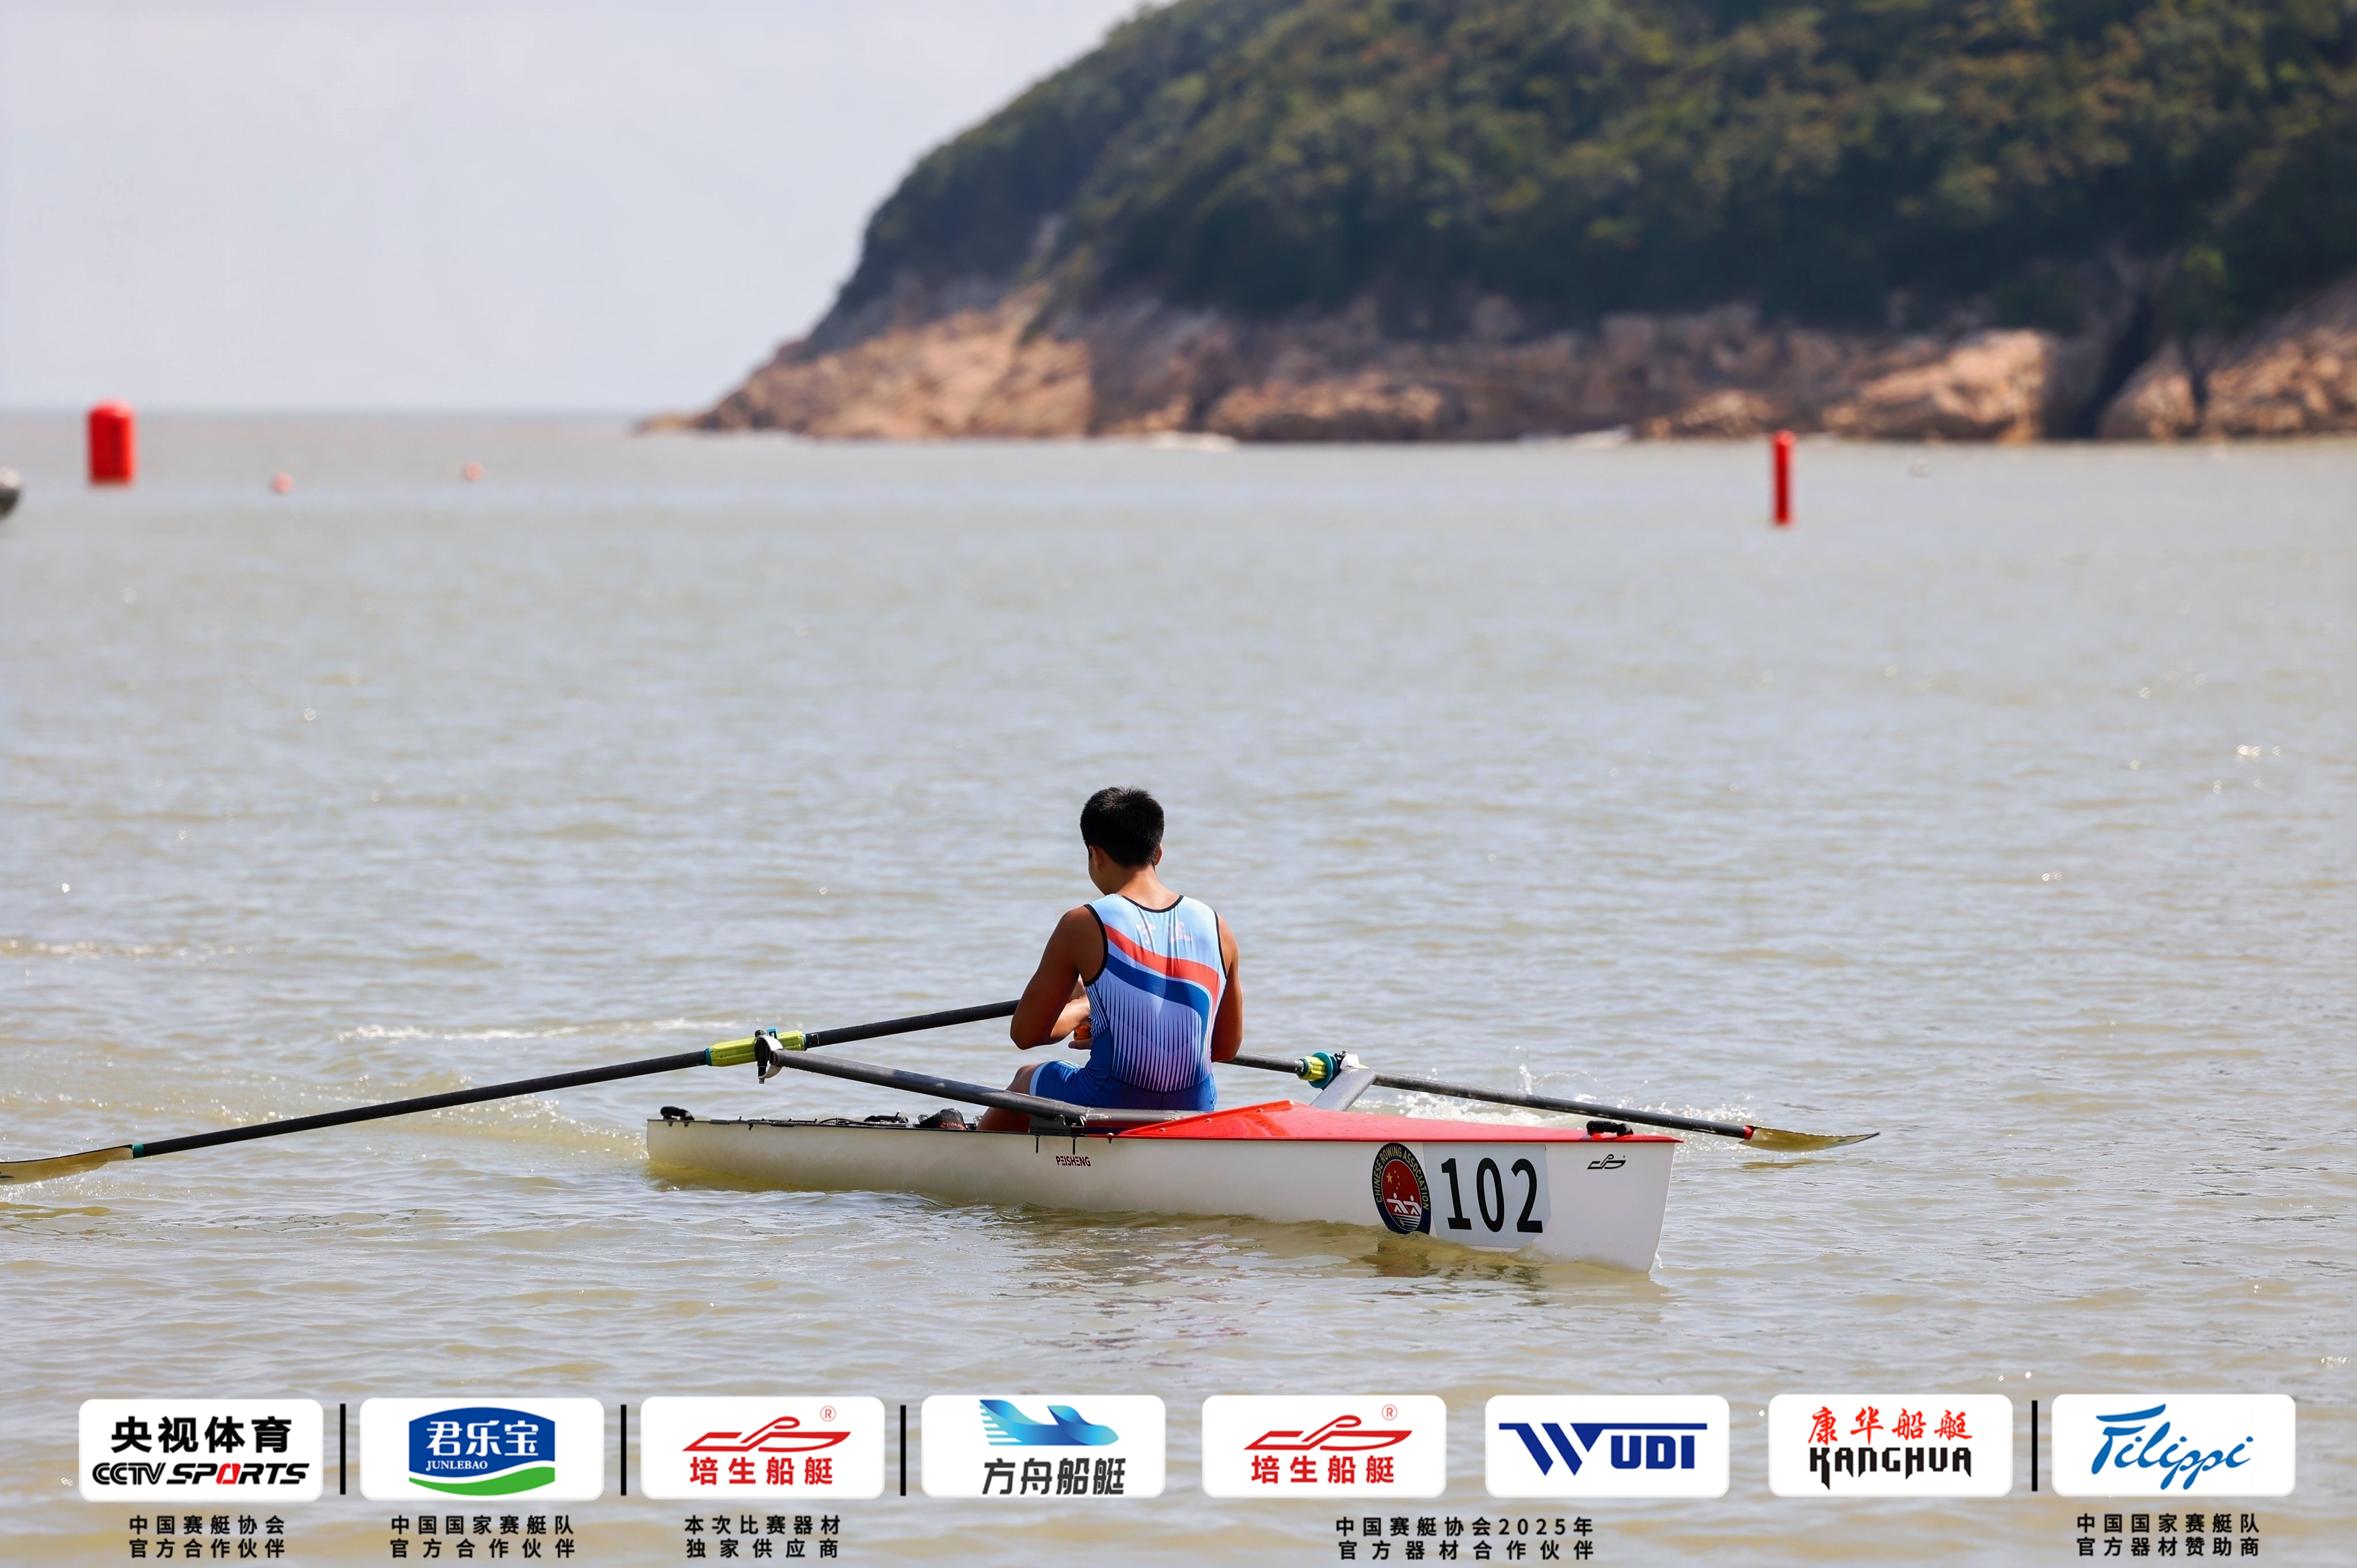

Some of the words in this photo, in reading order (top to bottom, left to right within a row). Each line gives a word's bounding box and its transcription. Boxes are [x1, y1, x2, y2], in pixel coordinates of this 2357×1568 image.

[1055, 1155, 1091, 1167] PEISHENG
[1373, 1159, 1384, 1203] CHINESE
[1380, 1145, 1402, 1164] ROWING
[1403, 1150, 1430, 1211] ASSOCIATION
[1441, 1158, 1543, 1233] 102
